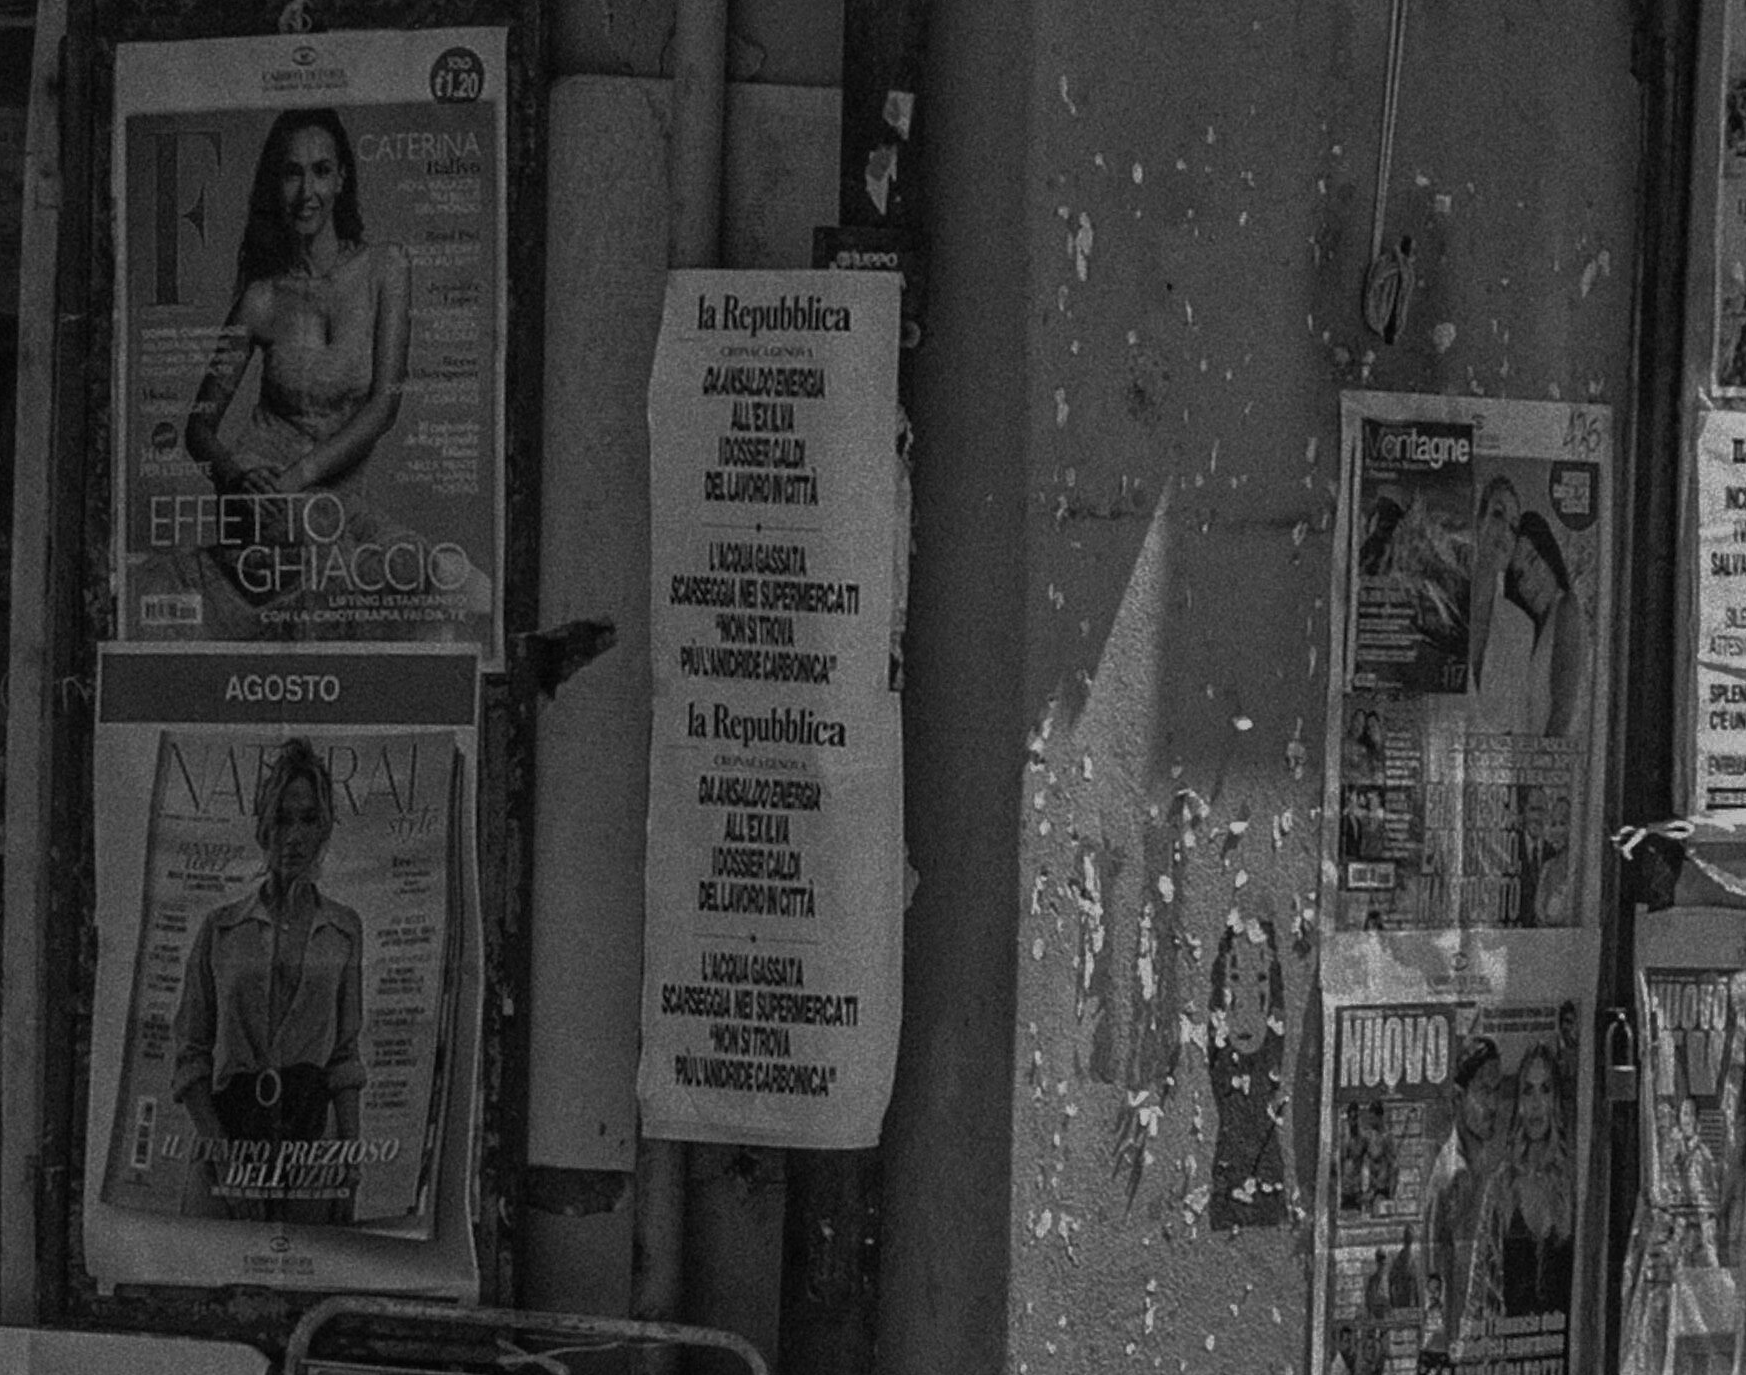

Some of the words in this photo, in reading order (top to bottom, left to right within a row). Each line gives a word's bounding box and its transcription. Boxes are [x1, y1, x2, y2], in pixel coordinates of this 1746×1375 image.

[358, 133, 480, 162] CATERINA
[697, 295, 715, 331] la
[724, 295, 850, 336] Repubblica
[151, 491, 345, 547] EFFETTO
[237, 541, 471, 594] GHIACCIO
[224, 673, 342, 703] AGOSTO
[687, 701, 707, 738] la
[713, 702, 846, 748] Repubblica
[756, 992, 858, 1026] SUPERMERCATI
[1339, 1013, 1449, 1089] NUOVO
[274, 1137, 401, 1165] PREZIOSO
